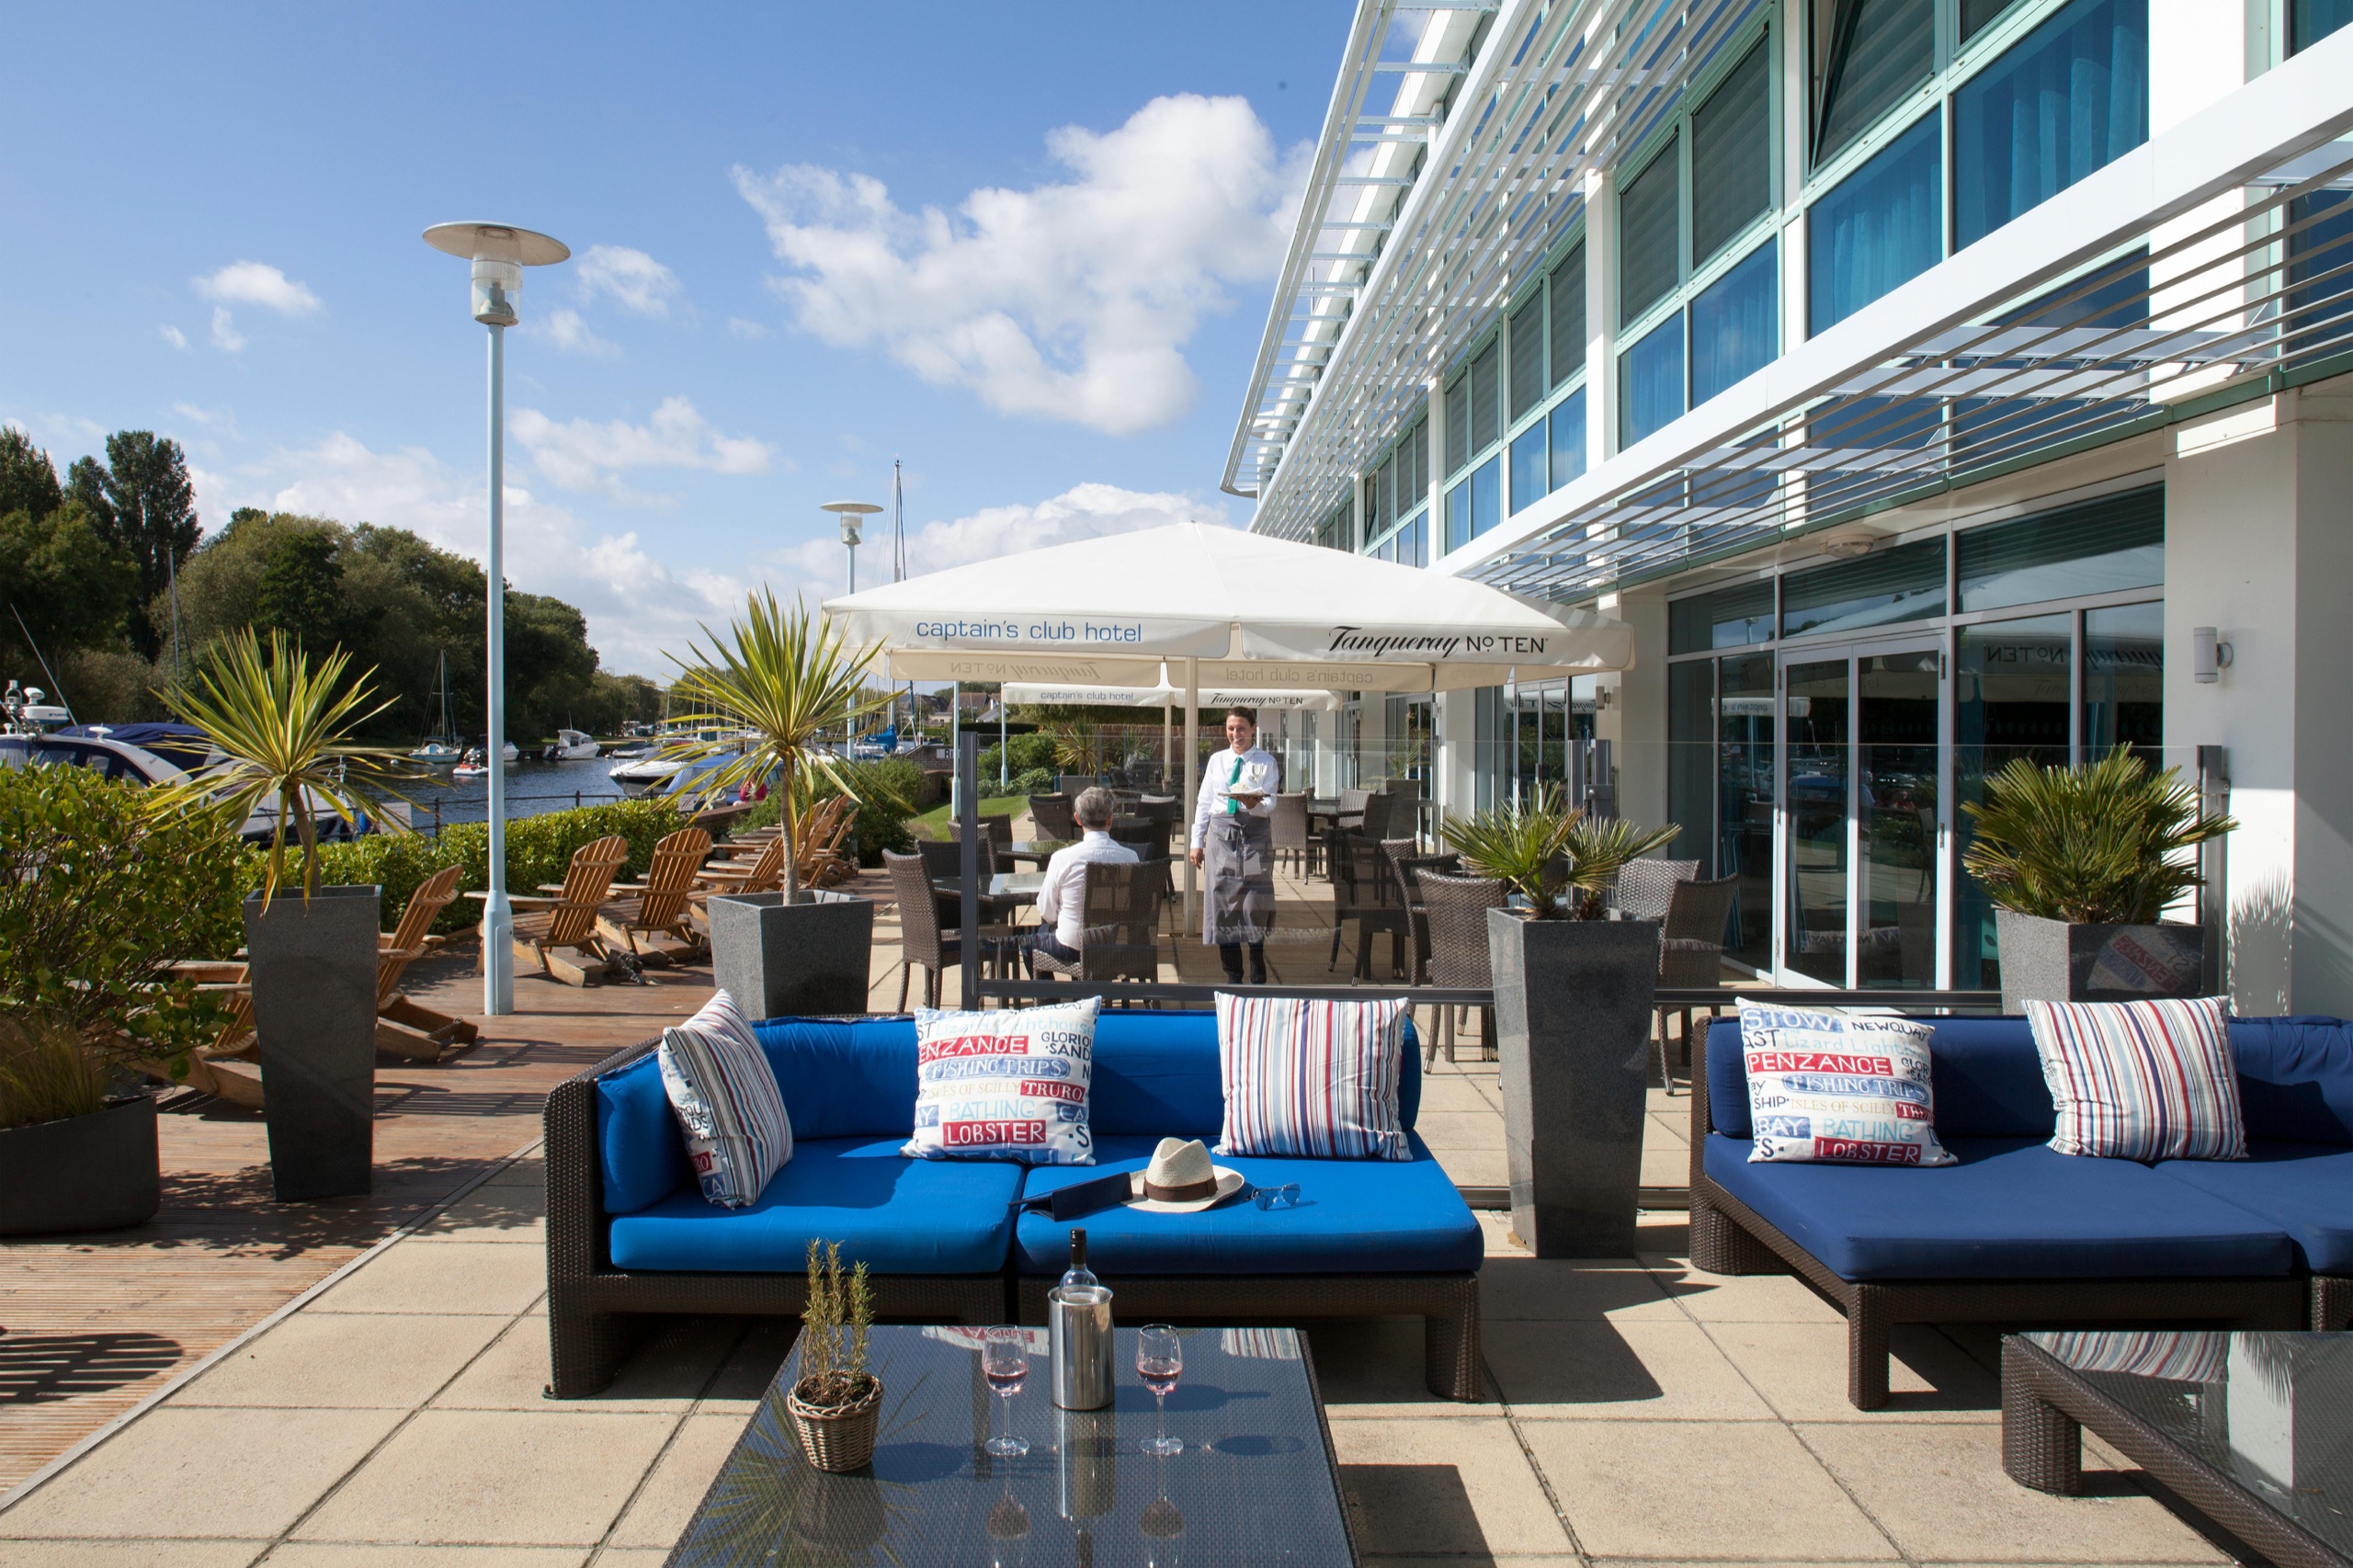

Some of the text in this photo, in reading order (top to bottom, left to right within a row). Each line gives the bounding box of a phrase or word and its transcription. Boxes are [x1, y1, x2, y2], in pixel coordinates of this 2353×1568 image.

[916, 619, 1142, 642] captain's club hotel
[1328, 625, 1461, 659] Tanqueray
[1040, 690, 1134, 701] captain's club hotel
[1210, 692, 1268, 707] Tanqueray
[1745, 1010, 1834, 1031] STOW
[1850, 1021, 1927, 1041] NEWQUAY
[932, 1058, 1062, 1080] FISHING TRIPS
[1747, 1053, 1890, 1074] PENZANCE
[959, 1084, 972, 1096] OF
[977, 1081, 1020, 1094] SCILLY
[1024, 1082, 1083, 1101] TRURO
[1793, 1075, 1925, 1100] FISHING TRIPS
[949, 1099, 1036, 1121] BATHING
[1790, 1098, 1895, 1115] ISLES OF SCILLY
[947, 1122, 1045, 1145] LOBSTER
[1823, 1118, 1913, 1142] BATHING
[1819, 1141, 1919, 1163] LOBSTER
